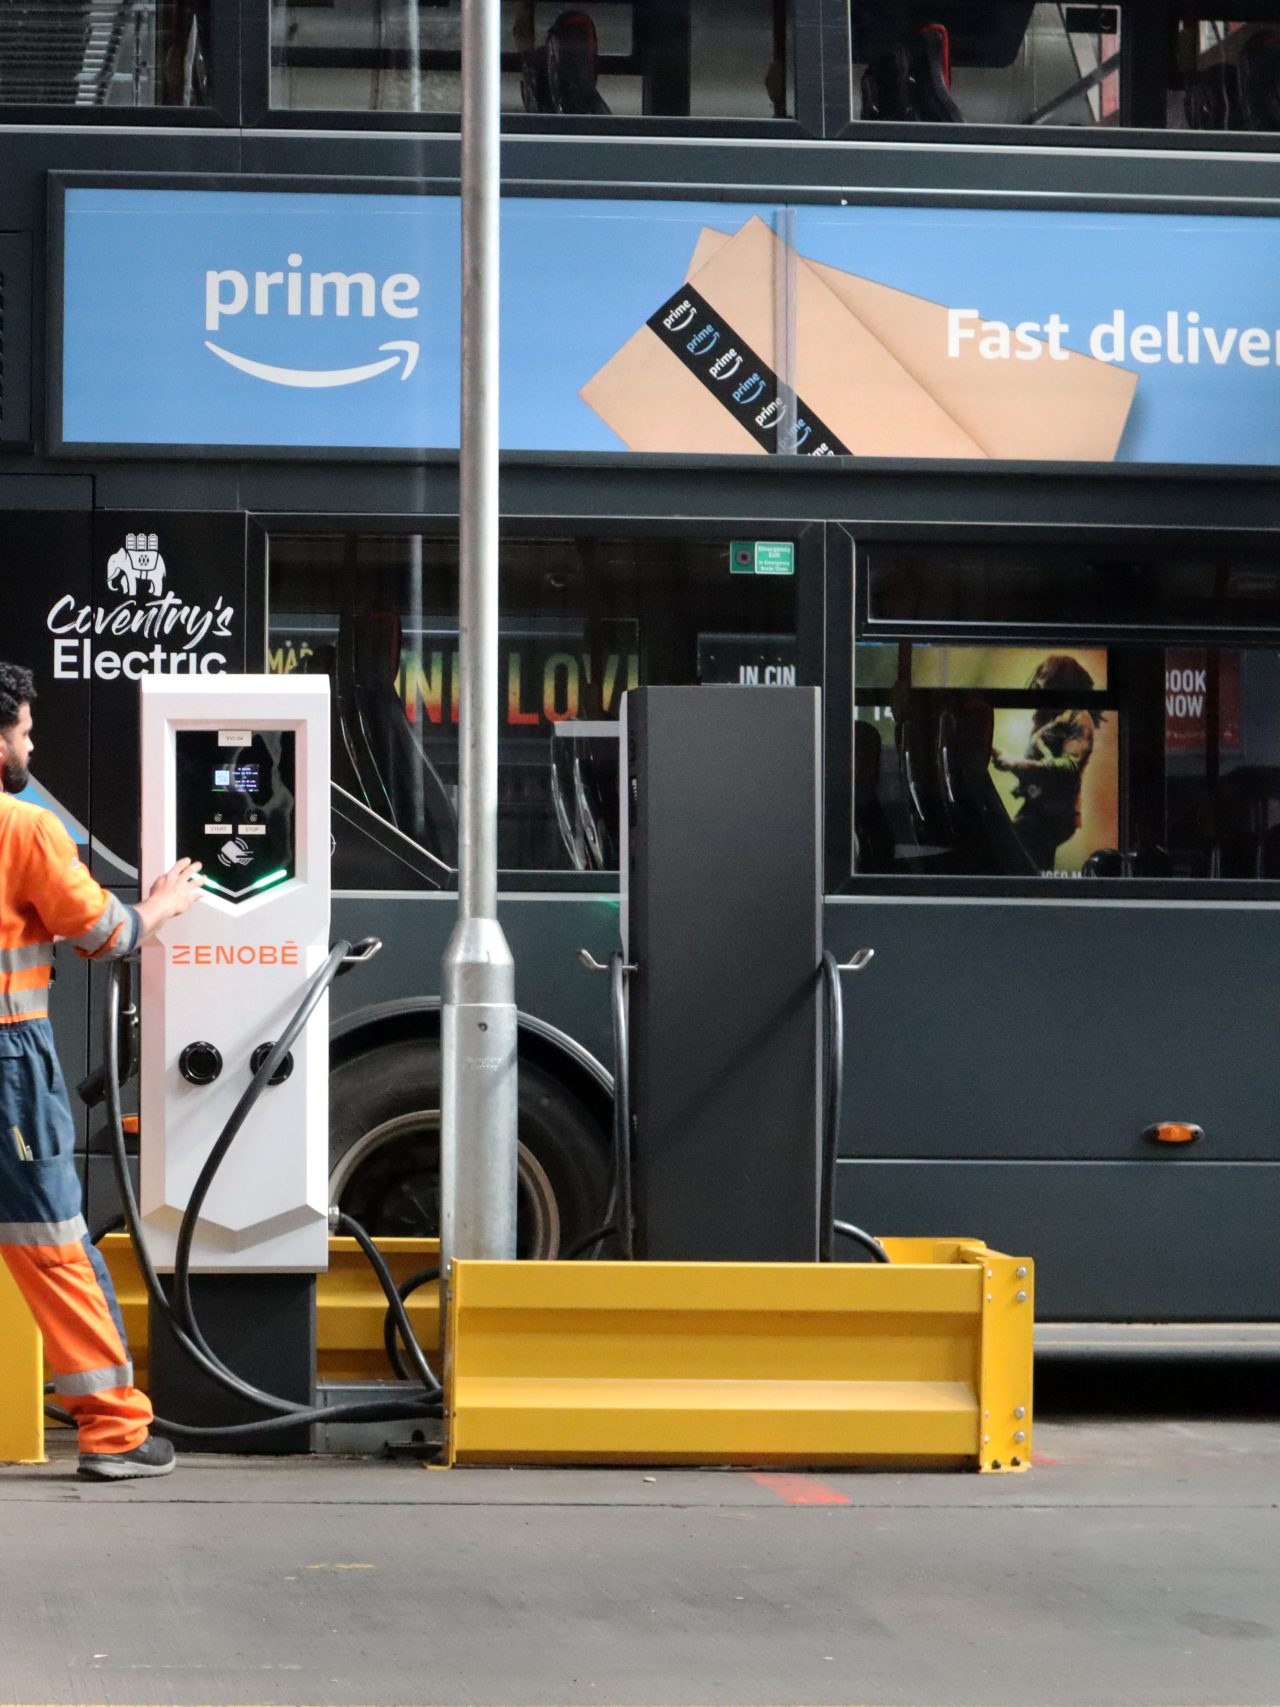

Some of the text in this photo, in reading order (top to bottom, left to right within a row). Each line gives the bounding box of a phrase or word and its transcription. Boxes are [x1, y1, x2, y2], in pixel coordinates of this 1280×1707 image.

[205, 253, 420, 331] prime
[663, 300, 691, 329] prime
[687, 324, 714, 353] prime
[947, 308, 1280, 367] Fast delive
[709, 348, 738, 378] prime
[732, 372, 761, 402] prime
[755, 397, 783, 426] prime
[47, 590, 234, 650] Coventry's
[53, 638, 227, 680] Electric
[740, 665, 759, 685] IN
[1166, 694, 1203, 718] NOW
